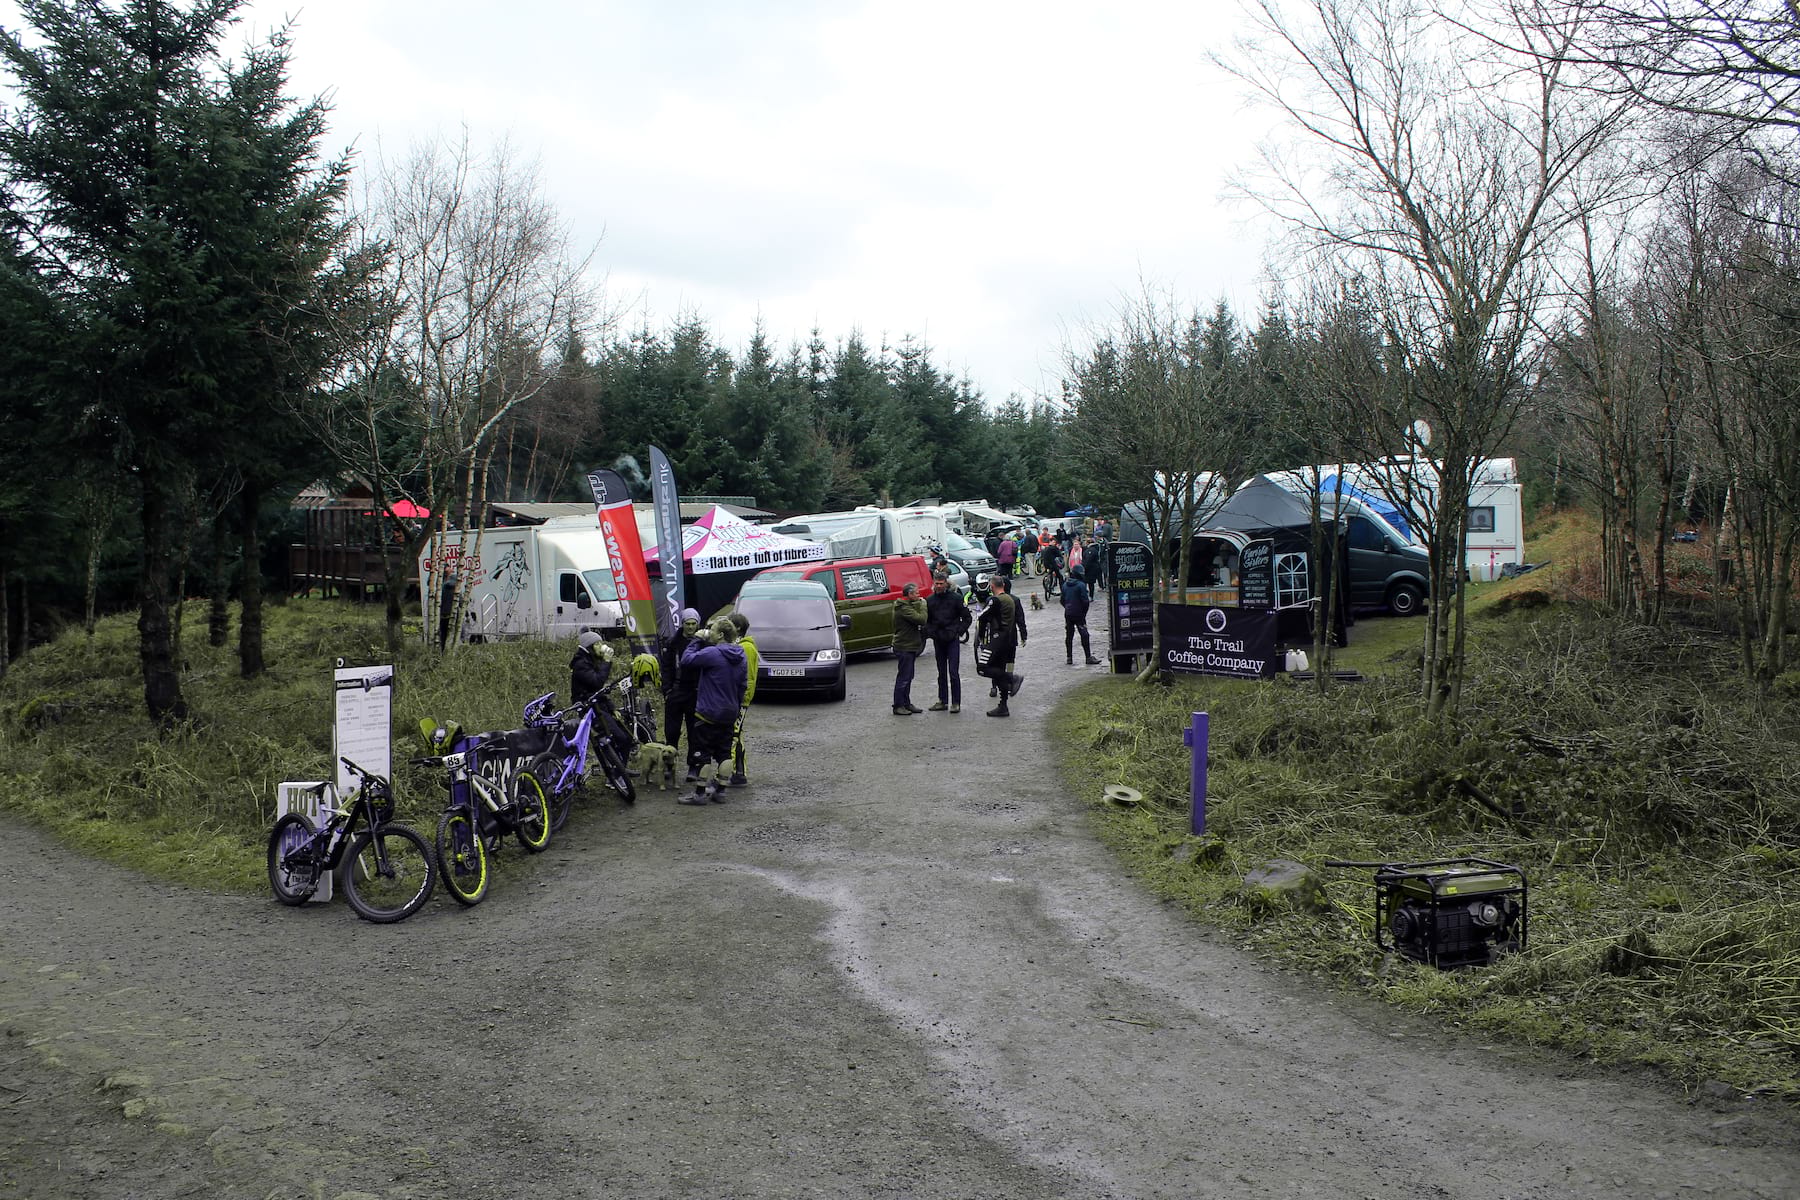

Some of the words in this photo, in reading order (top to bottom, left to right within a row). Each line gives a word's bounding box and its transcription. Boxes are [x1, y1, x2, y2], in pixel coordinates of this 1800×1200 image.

[710, 556, 727, 569] flat
[730, 554, 750, 567] free
[754, 550, 771, 564] full
[773, 549, 783, 562] of
[784, 548, 808, 560] fibre
[1118, 580, 1131, 589] FOR
[1133, 579, 1149, 588] HIRE
[1188, 636, 1211, 650] The
[1213, 639, 1244, 653] Trail
[1167, 650, 1205, 665] Coffee
[1207, 653, 1265, 673] Company
[448, 755, 460, 766] 85
